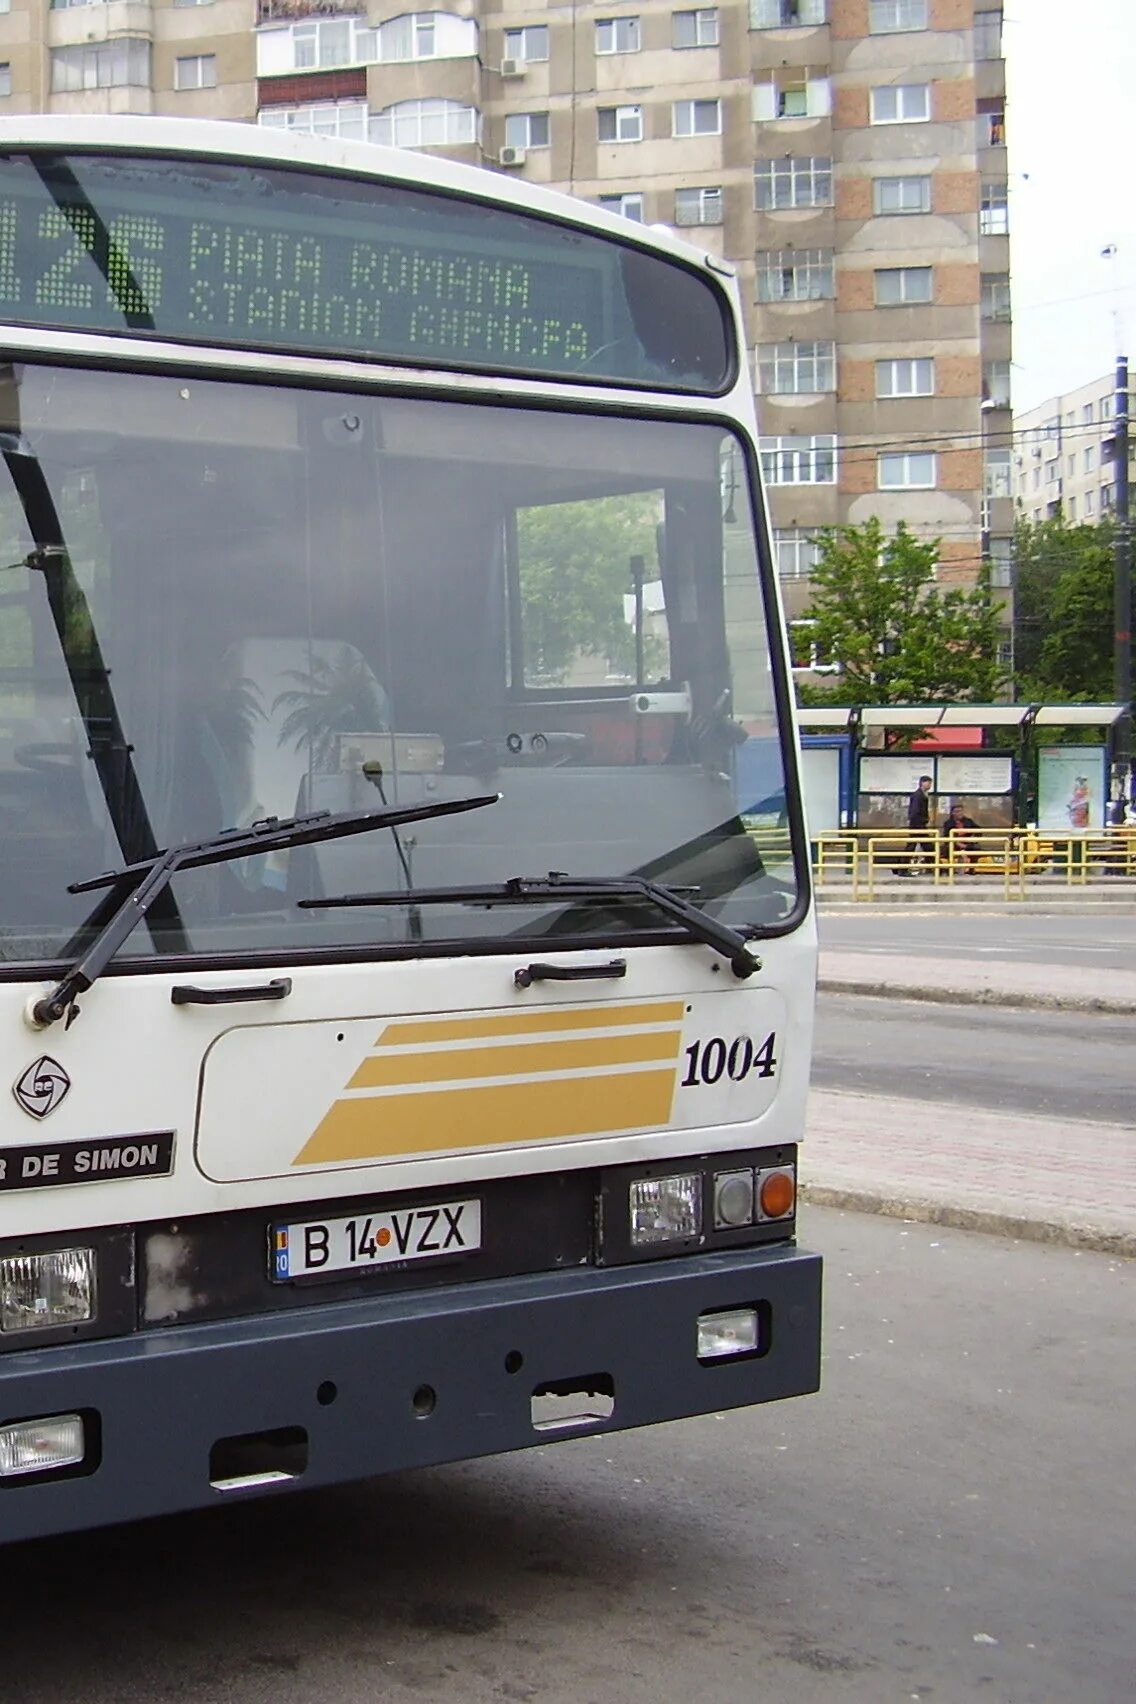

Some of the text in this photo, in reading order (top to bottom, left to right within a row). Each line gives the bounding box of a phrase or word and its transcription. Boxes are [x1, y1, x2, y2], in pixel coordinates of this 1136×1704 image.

[190, 222, 529, 310] PIATA ROMANA
[681, 1031, 777, 1087] 1004
[21, 1154, 61, 1178] DE
[74, 1144, 159, 1173] SIMON
[304, 1205, 465, 1269] B 14 VZX
